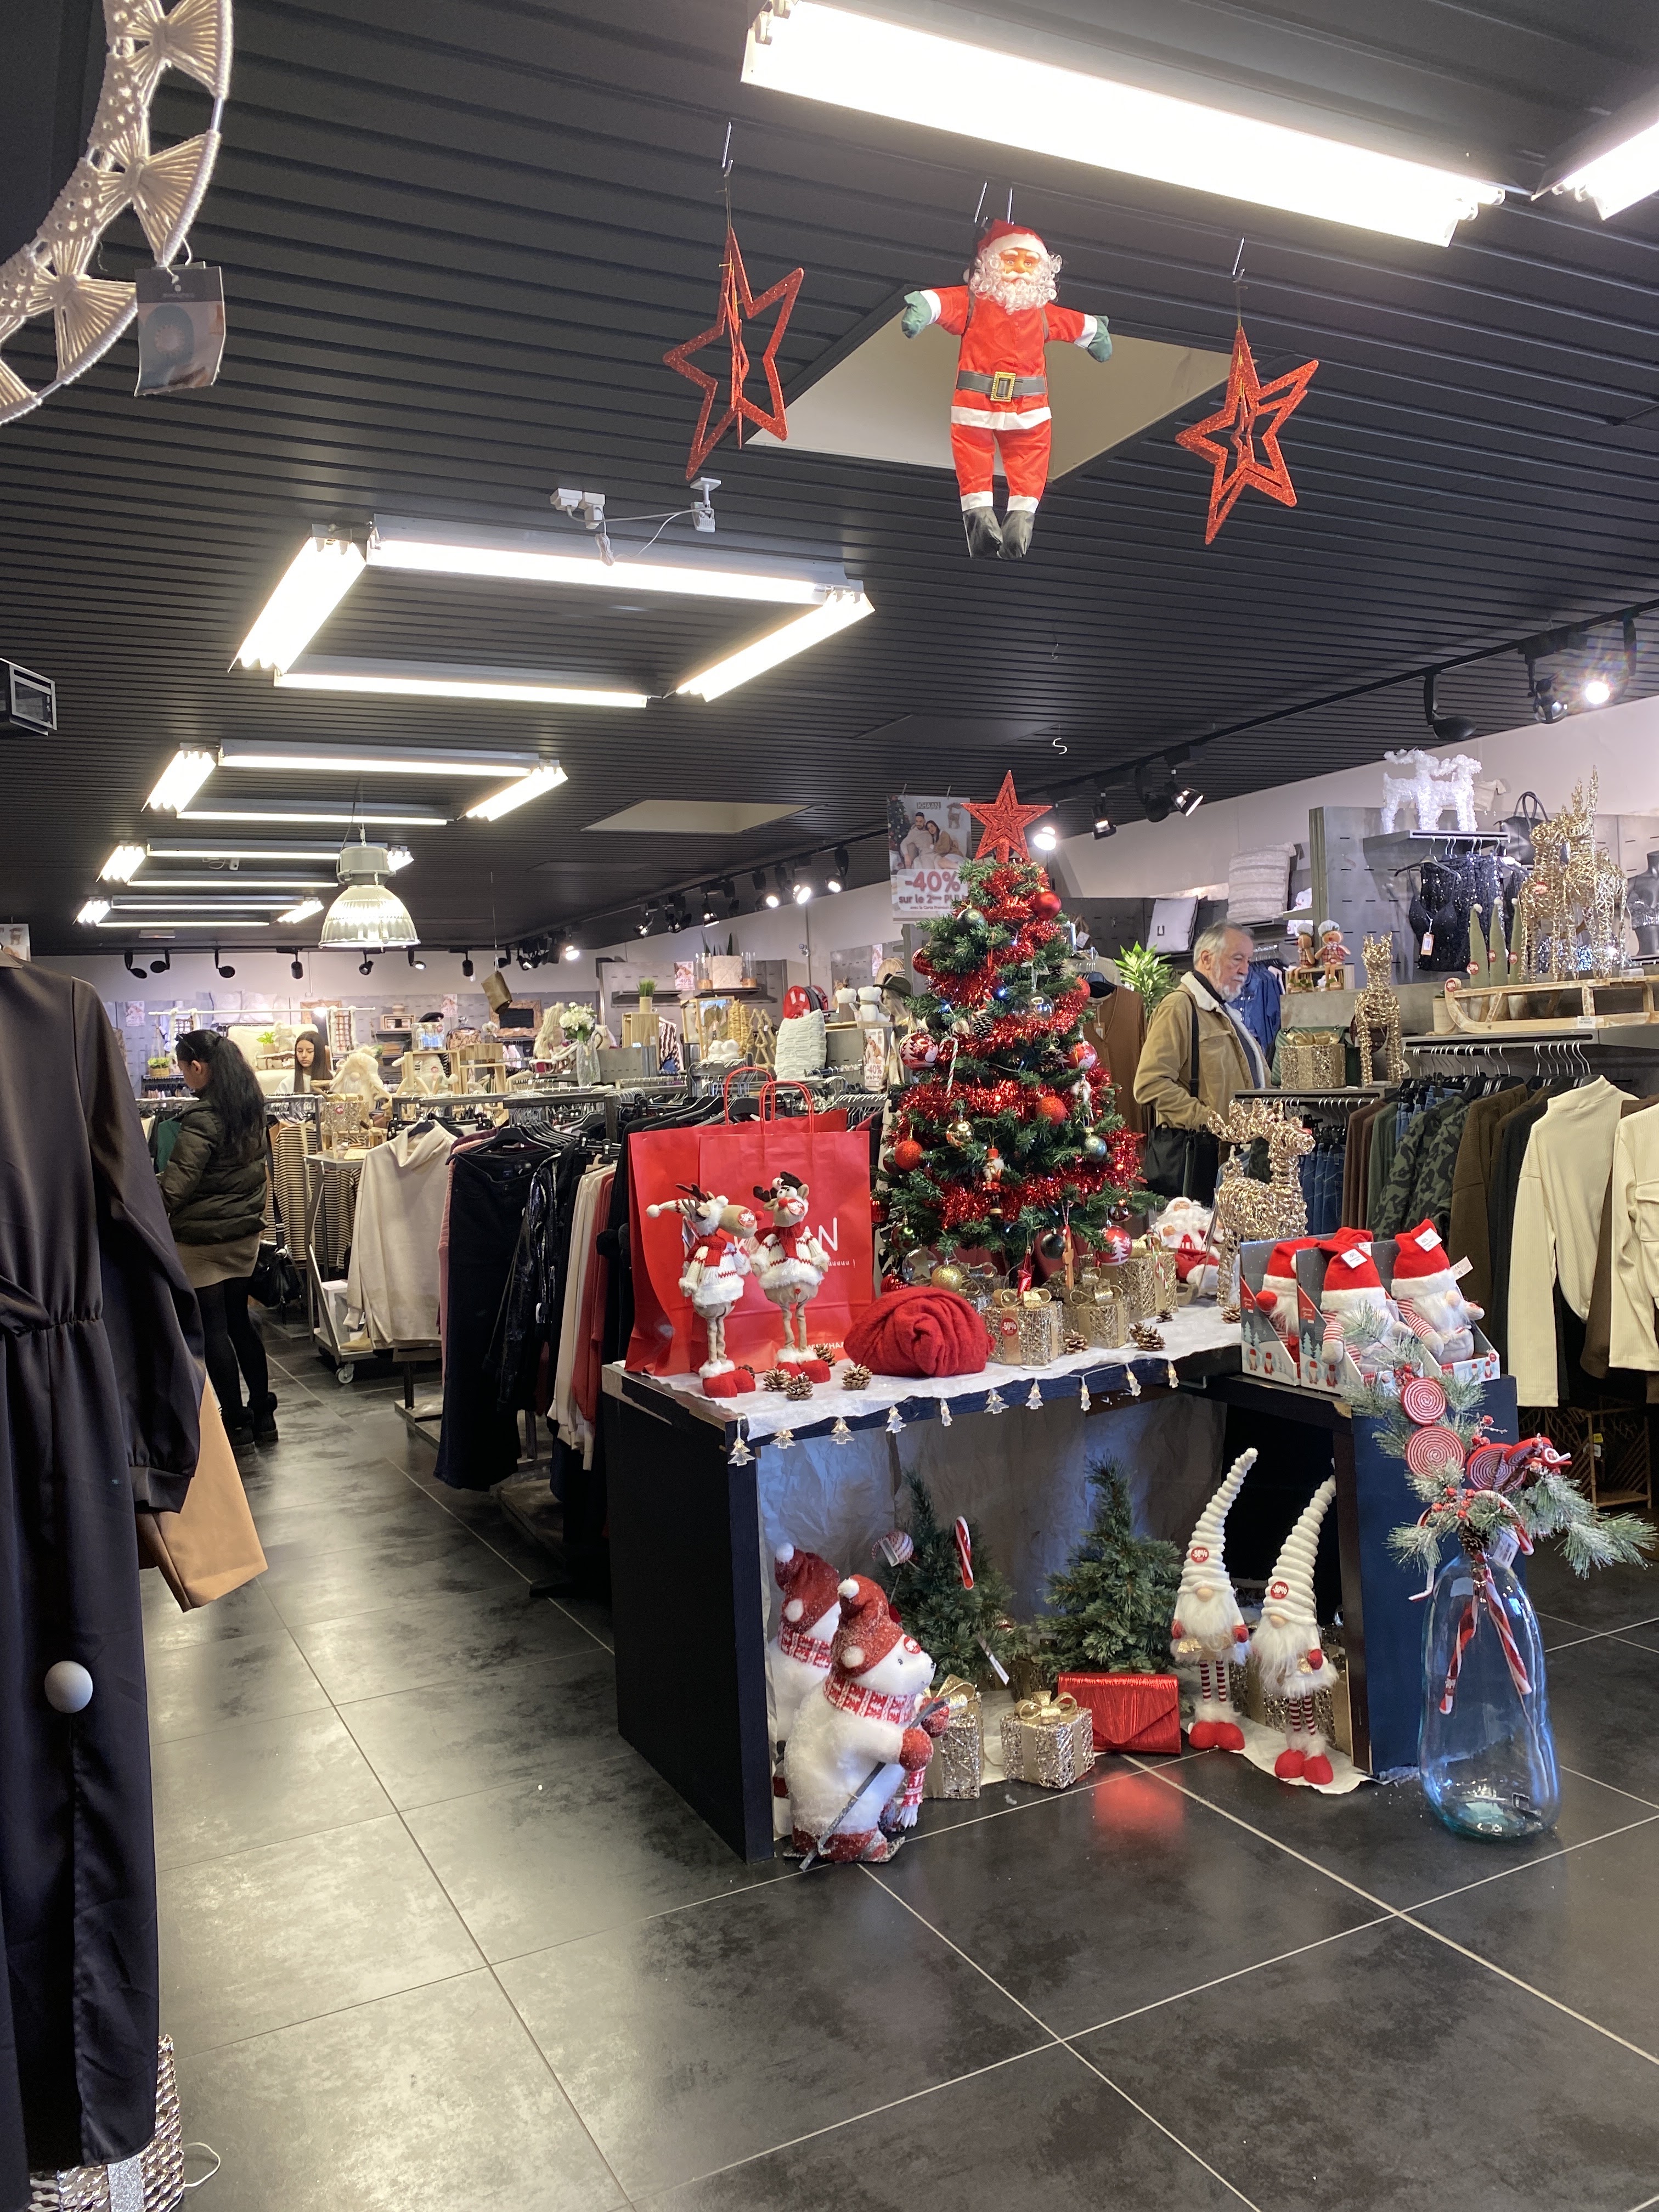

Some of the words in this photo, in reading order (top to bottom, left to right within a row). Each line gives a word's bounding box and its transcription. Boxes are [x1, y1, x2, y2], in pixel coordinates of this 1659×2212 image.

[905, 871, 961, 892] -40%
[915, 894, 924, 904] le
[867, 1065, 882, 1074] -40%
[740, 1211, 755, 1222] -50%
[1002, 1322, 1017, 1330] -50%
[1272, 1586, 1288, 1595] -50%
